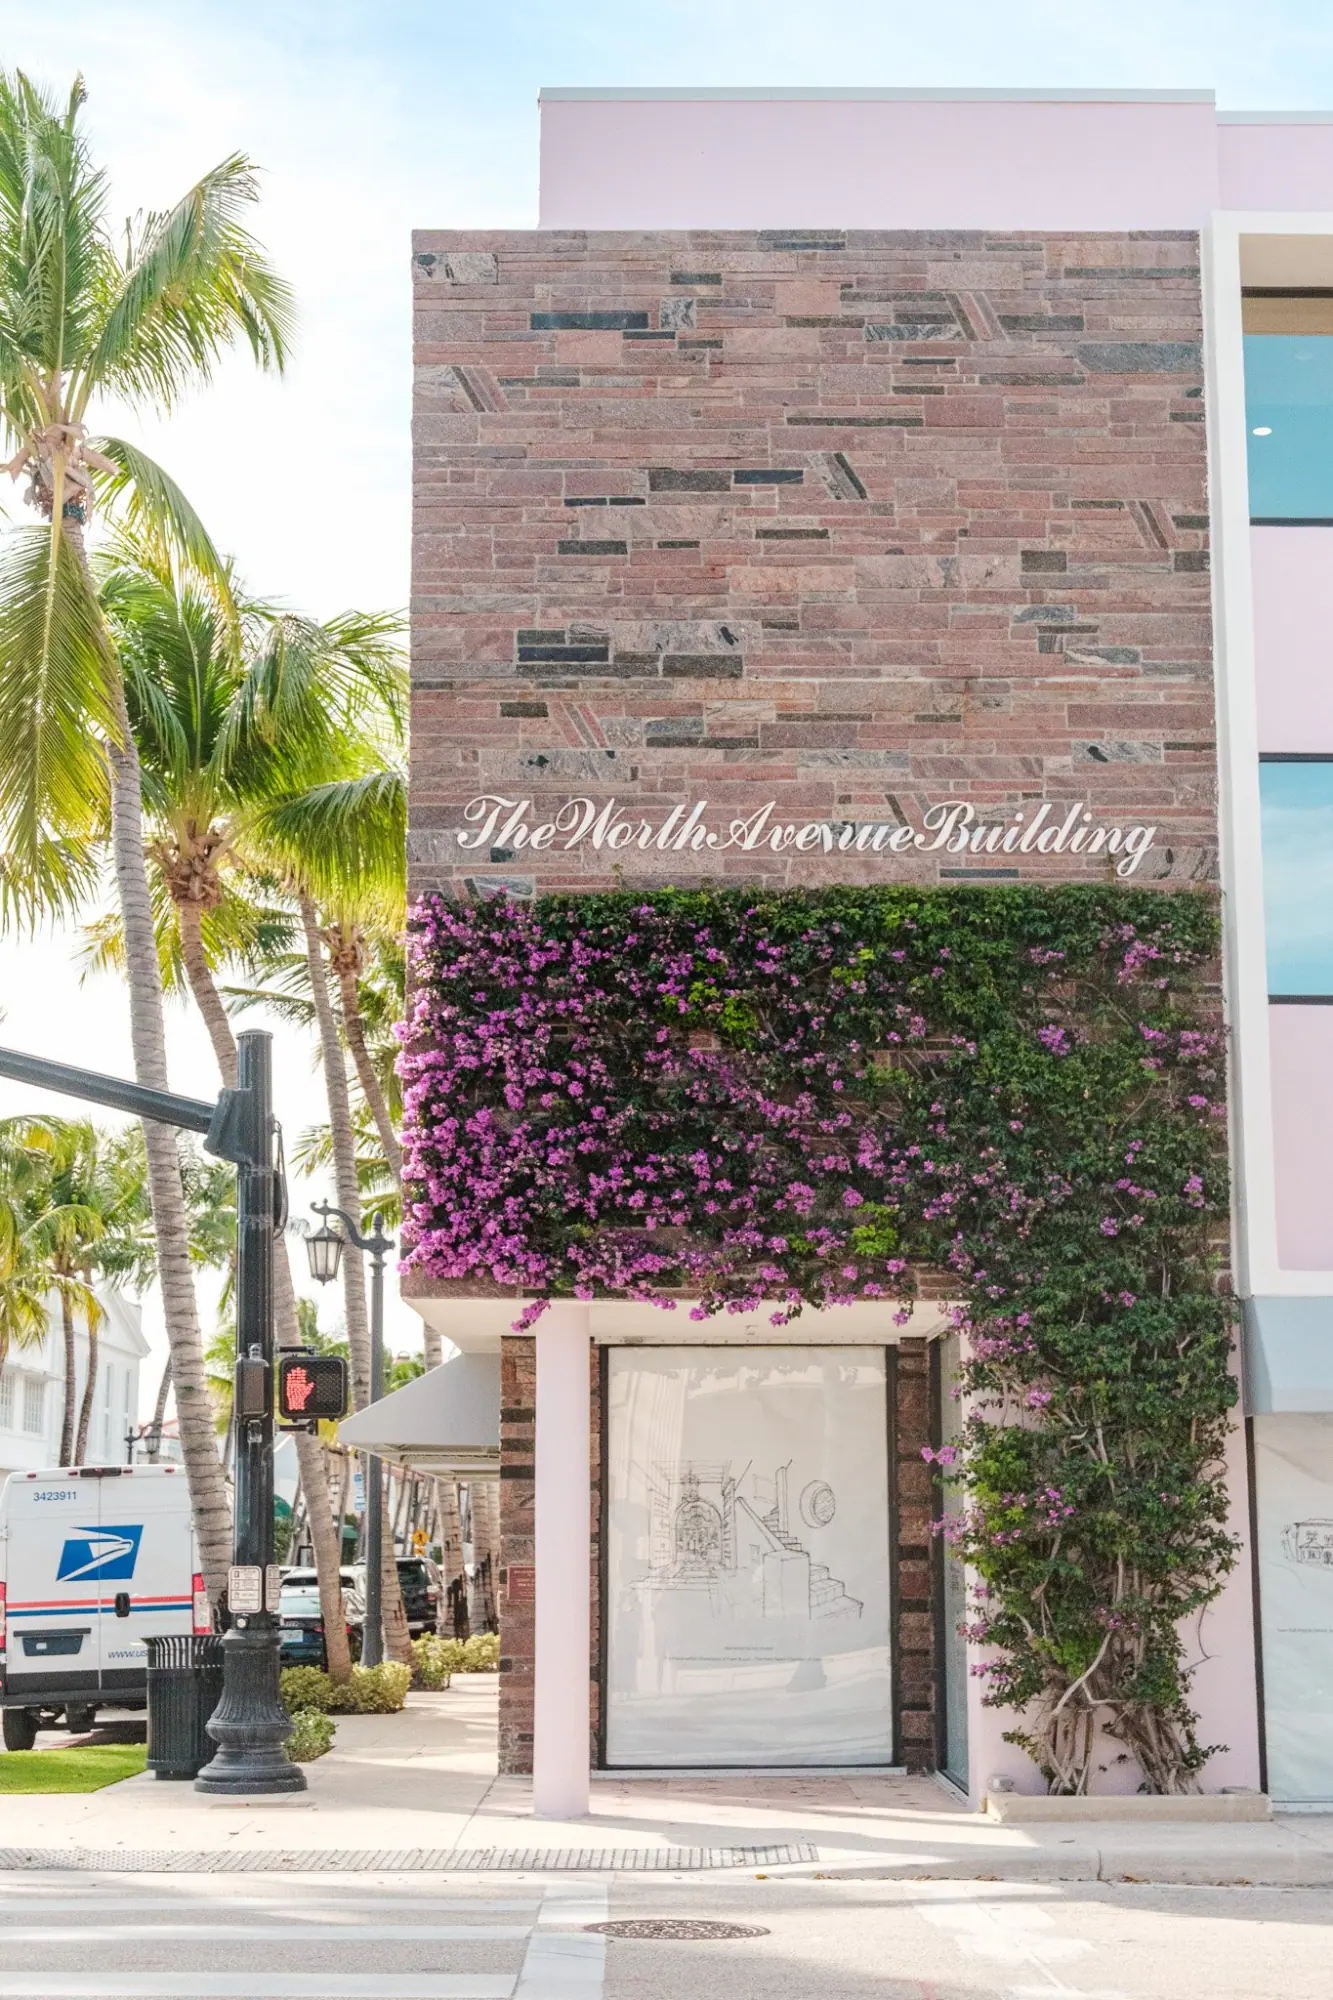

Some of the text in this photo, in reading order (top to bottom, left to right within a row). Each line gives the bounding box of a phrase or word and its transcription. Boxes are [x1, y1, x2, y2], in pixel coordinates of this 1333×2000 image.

[457, 795, 1157, 877] The Worth Avenue Building
[33, 1491, 77, 1501] 3423911
[107, 1649, 148, 1659] www.us
